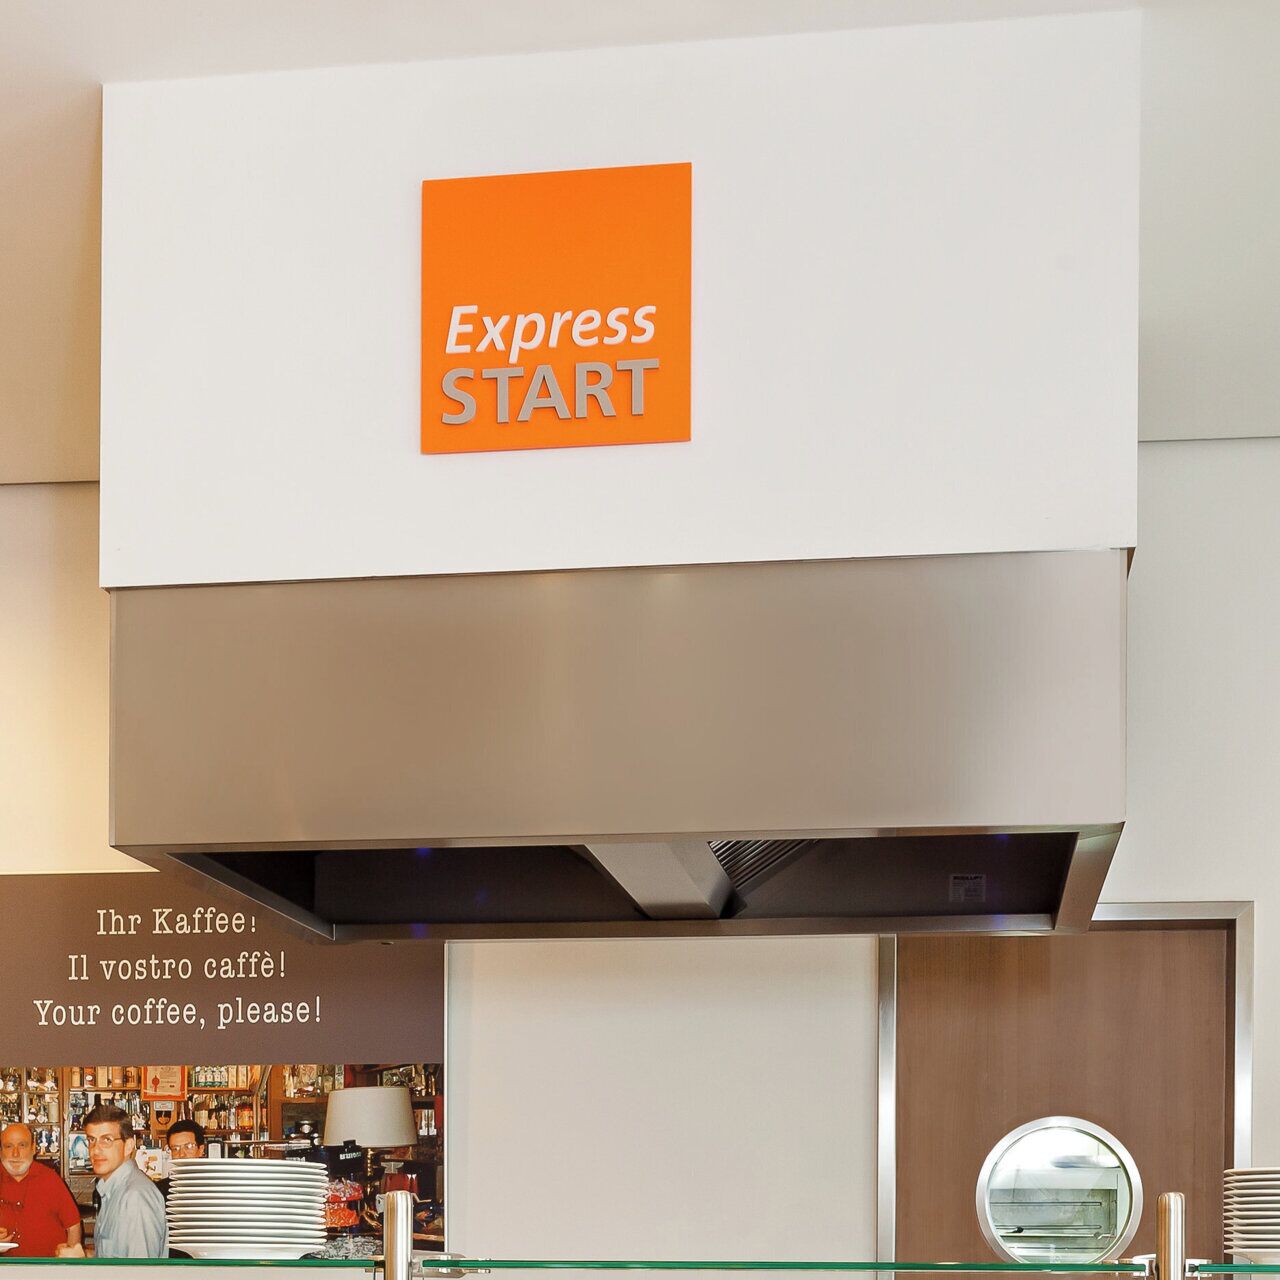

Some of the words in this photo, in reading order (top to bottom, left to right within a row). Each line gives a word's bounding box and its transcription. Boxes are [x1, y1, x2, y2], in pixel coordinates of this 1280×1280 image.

[445, 304, 657, 364] Express
[441, 358, 660, 425] START
[96, 909, 142, 935] Ihr
[152, 906, 257, 934] Kaffee!
[68, 954, 90, 981] Il
[100, 954, 192, 980] vostro
[204, 950, 286, 979] caffè!
[33, 999, 101, 1026] Your
[111, 997, 206, 1030] coffee,
[217, 995, 322, 1030] please!
